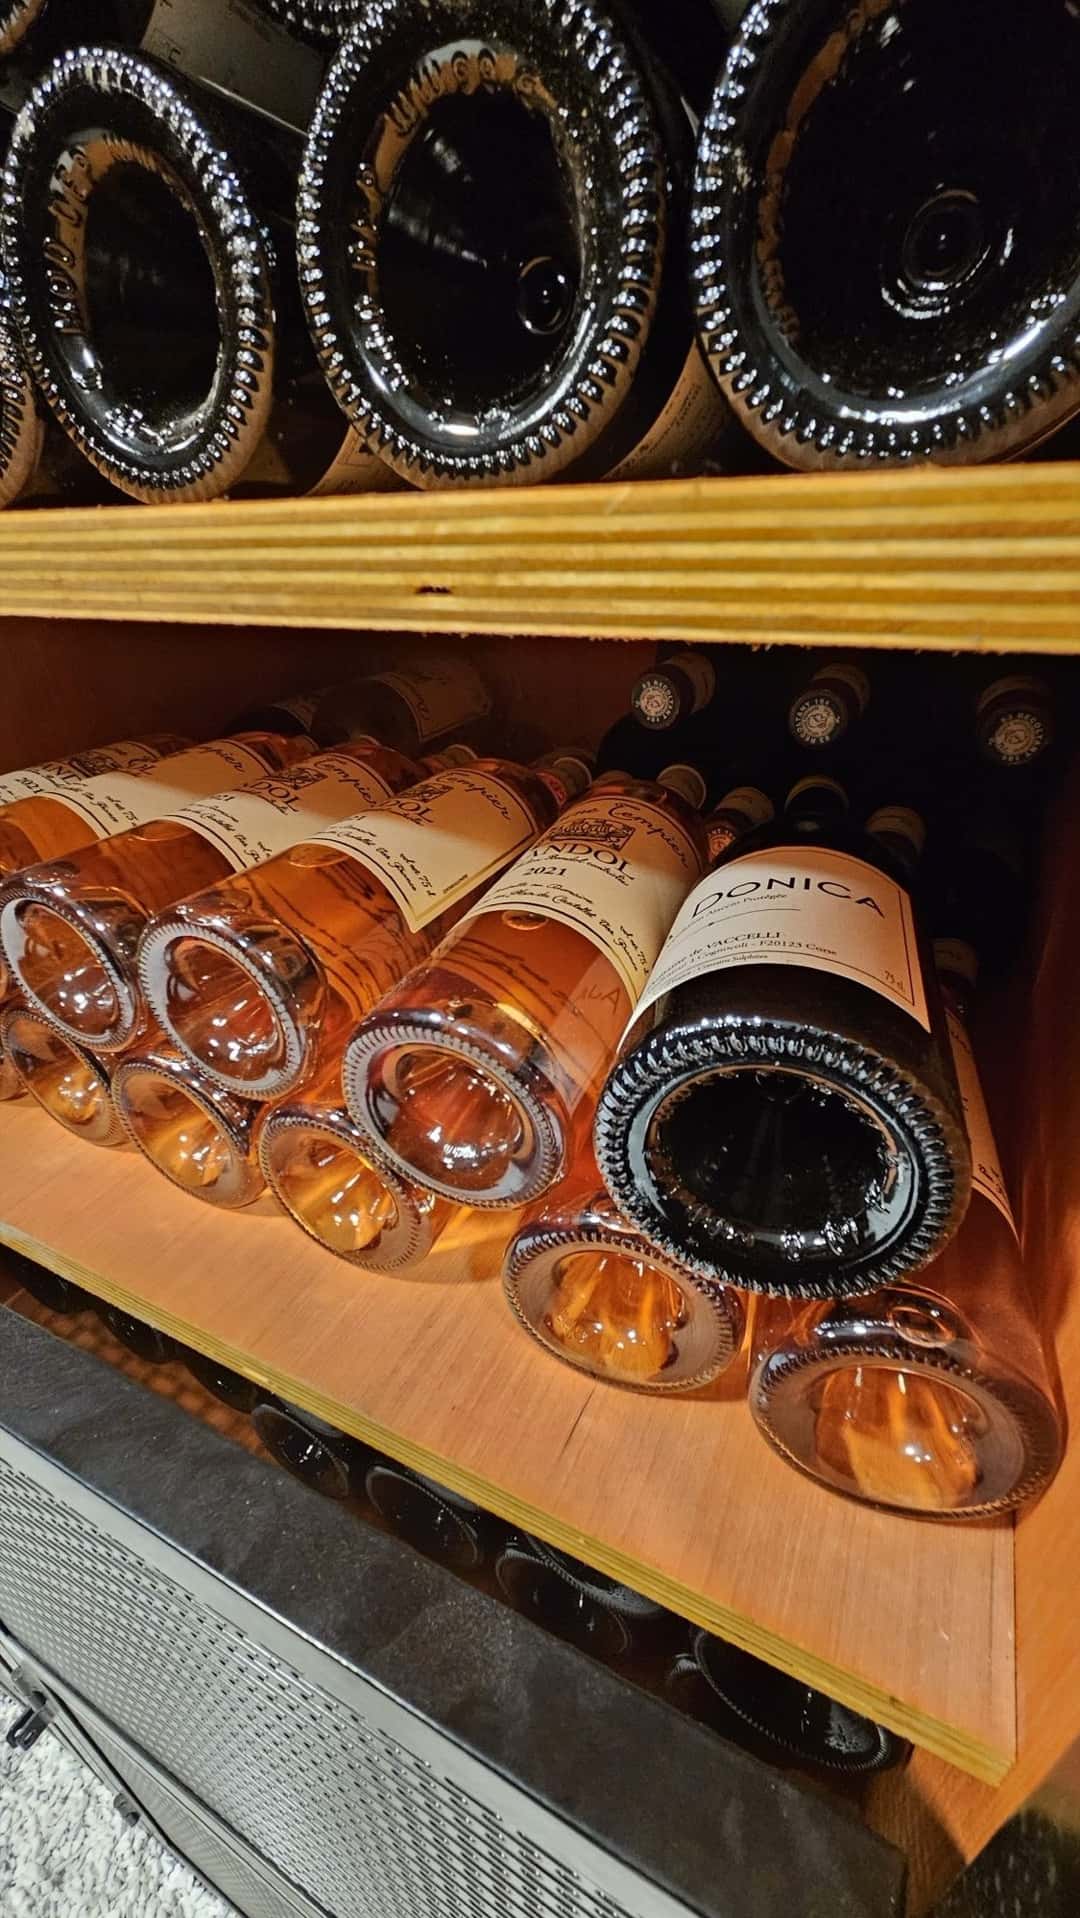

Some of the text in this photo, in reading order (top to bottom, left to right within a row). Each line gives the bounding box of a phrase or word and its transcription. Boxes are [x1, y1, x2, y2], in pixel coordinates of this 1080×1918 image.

[243, 780, 300, 813] DOL
[382, 799, 435, 824] DOL
[608, 802, 690, 869] Tempier
[522, 866, 567, 877] 2021
[532, 842, 635, 882] ANDOL
[418, 874, 433, 888] 75
[691, 876, 886, 919] DONICA
[705, 931, 782, 952] VACCELLI
[759, 939, 803, 949] F20123
[804, 943, 838, 956] Corse
[884, 969, 896, 985] 75
